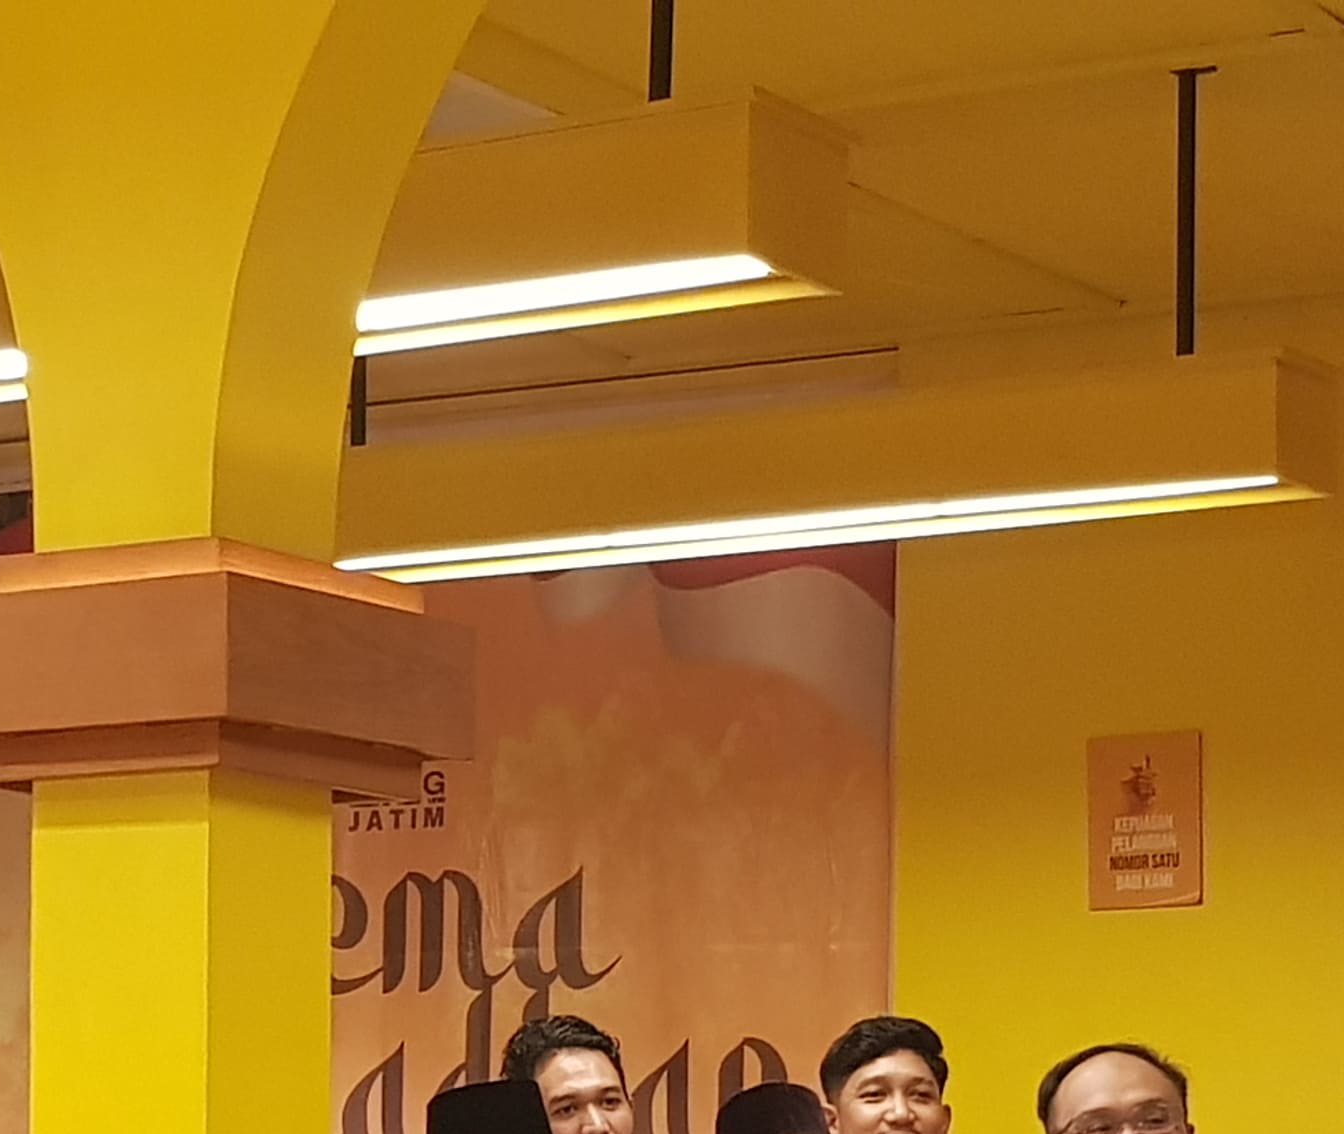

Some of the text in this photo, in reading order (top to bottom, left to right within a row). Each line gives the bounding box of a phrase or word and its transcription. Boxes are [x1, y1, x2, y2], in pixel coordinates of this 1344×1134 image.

[348, 807, 445, 832] JATIM
[1109, 852, 1180, 871] NOMOR SATU
[1144, 872, 1174, 889] KAMI
